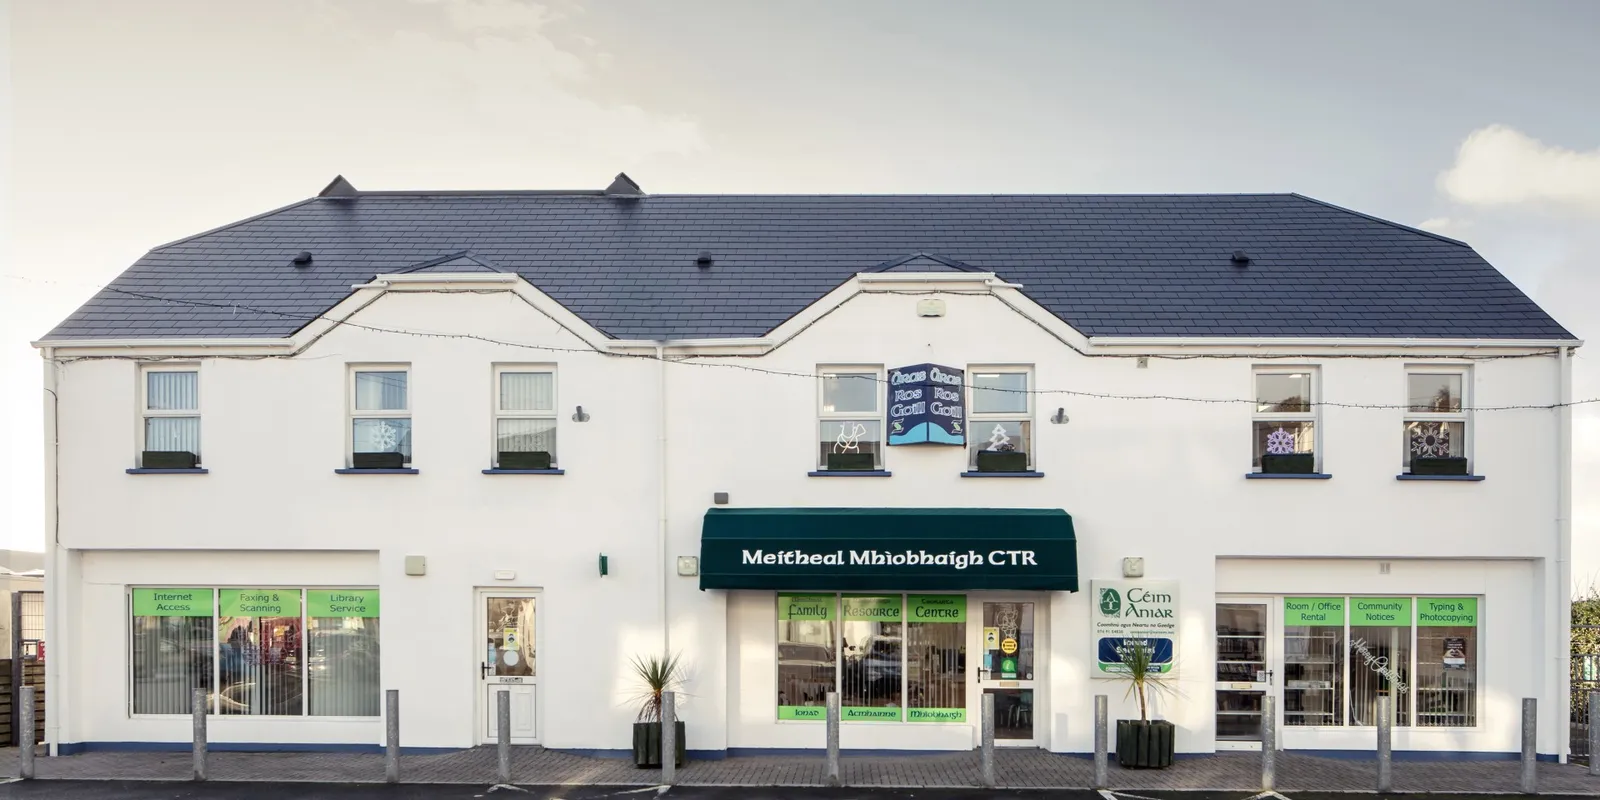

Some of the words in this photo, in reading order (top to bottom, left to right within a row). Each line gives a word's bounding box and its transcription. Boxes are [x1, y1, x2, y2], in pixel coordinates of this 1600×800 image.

[894, 388, 923, 402] Ros
[934, 387, 959, 402] Ros
[742, 549, 845, 566] Meitheal
[988, 550, 1038, 566] CTR
[153, 592, 192, 601] Internet
[240, 594, 270, 603] Faxing
[272, 594, 280, 602] &
[330, 594, 364, 603] Library
[1126, 587, 1172, 603] Céim
[156, 603, 191, 611] Access
[240, 604, 281, 613] Scanning
[329, 604, 366, 612] Service
[1286, 602, 1309, 610] Room
[1311, 602, 1315, 611] /
[1317, 602, 1341, 610] Office
[1357, 602, 1403, 611] Community
[1429, 602, 1455, 612] Typing
[1457, 602, 1464, 611] &
[787, 603, 827, 620] Family
[843, 604, 900, 618] Resource
[915, 605, 959, 618] Centre
[1300, 613, 1326, 621] Rental
[1365, 613, 1395, 621] Notices
[1420, 613, 1473, 623] Photocopying
[794, 708, 820, 717] Ionad
[847, 709, 897, 718] Acmhainne
